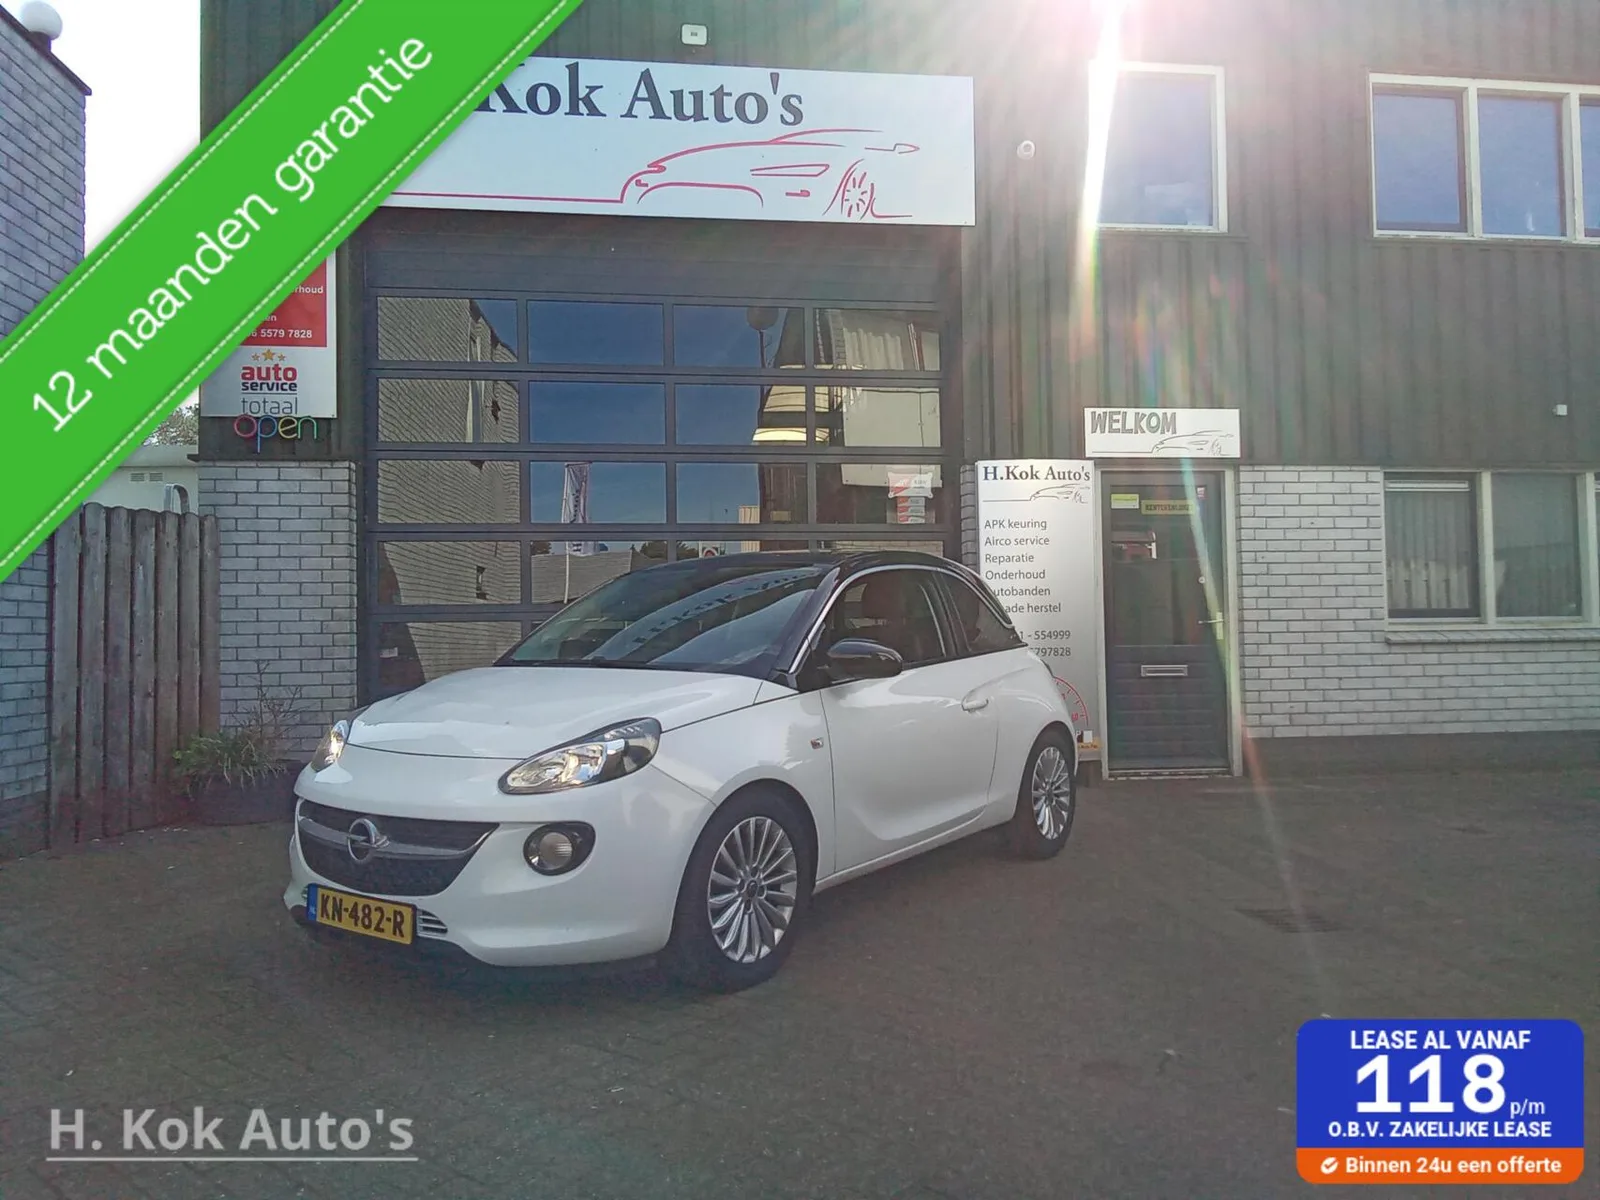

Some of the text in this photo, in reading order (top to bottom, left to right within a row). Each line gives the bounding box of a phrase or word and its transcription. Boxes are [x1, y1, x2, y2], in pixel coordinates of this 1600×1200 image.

[620, 67, 804, 126] Auto's
[294, 285, 324, 294] rhoud
[260, 329, 285, 339] 5579
[288, 329, 313, 339] 7828
[241, 363, 298, 382] auto
[241, 381, 298, 392] service
[241, 397, 298, 415] totaal
[1090, 410, 1177, 435] WELKOM
[233, 414, 318, 454] open
[983, 465, 1091, 481] H.Kok Auto's
[984, 518, 1047, 531] APK keuring
[984, 535, 1050, 547] Airco service
[985, 553, 1035, 566] Reparatie
[985, 569, 1046, 580] Onderhoud
[993, 585, 1051, 597] utobanden
[1004, 602, 1061, 613] ade herstel
[1033, 629, 1071, 640] 554999
[1031, 646, 1071, 657] 797828
[320, 893, 405, 938] KN-482-R
